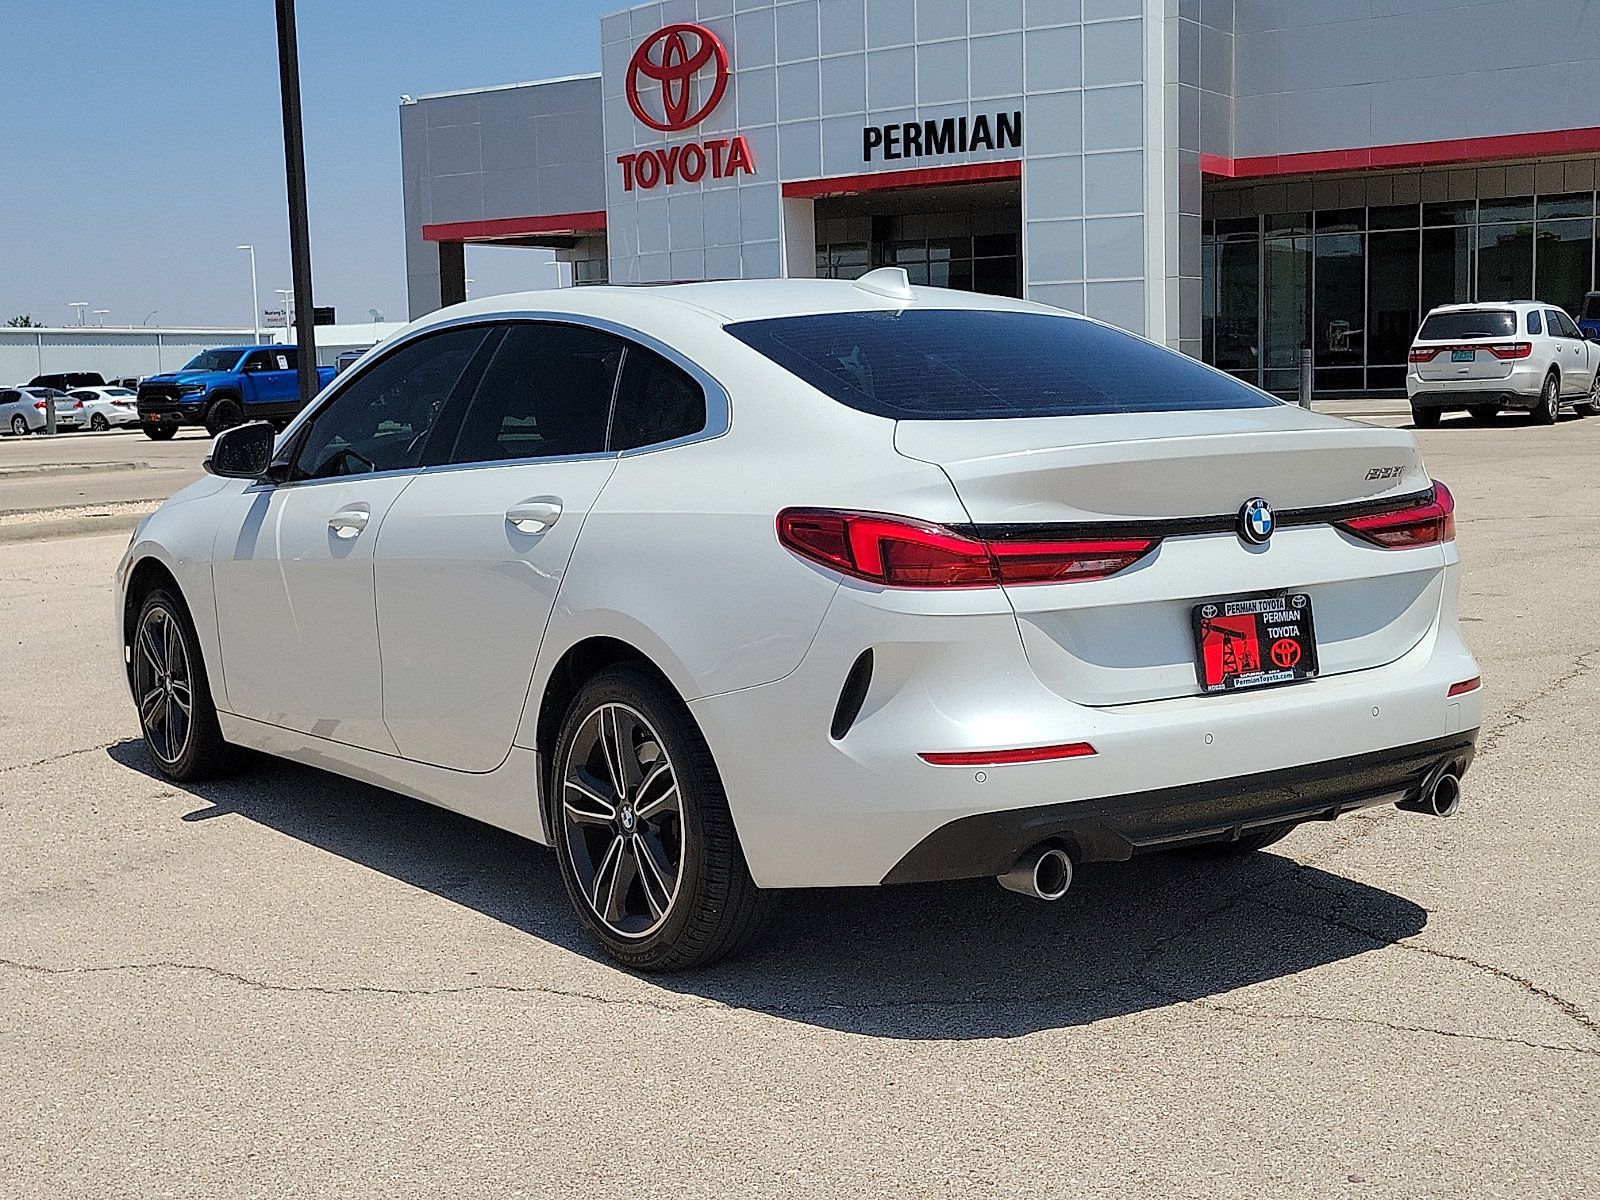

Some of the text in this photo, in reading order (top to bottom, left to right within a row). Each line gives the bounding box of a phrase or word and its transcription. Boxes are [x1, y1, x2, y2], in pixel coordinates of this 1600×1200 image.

[863, 111, 1022, 162] PERMIAN
[617, 136, 757, 192] TOYOTA
[1226, 598, 1285, 614] PERMIAN TOYOTA
[1263, 610, 1301, 624] PERMIAN
[1267, 625, 1300, 639] TOYOTA
[1235, 673, 1293, 686] PermianToyota.com
